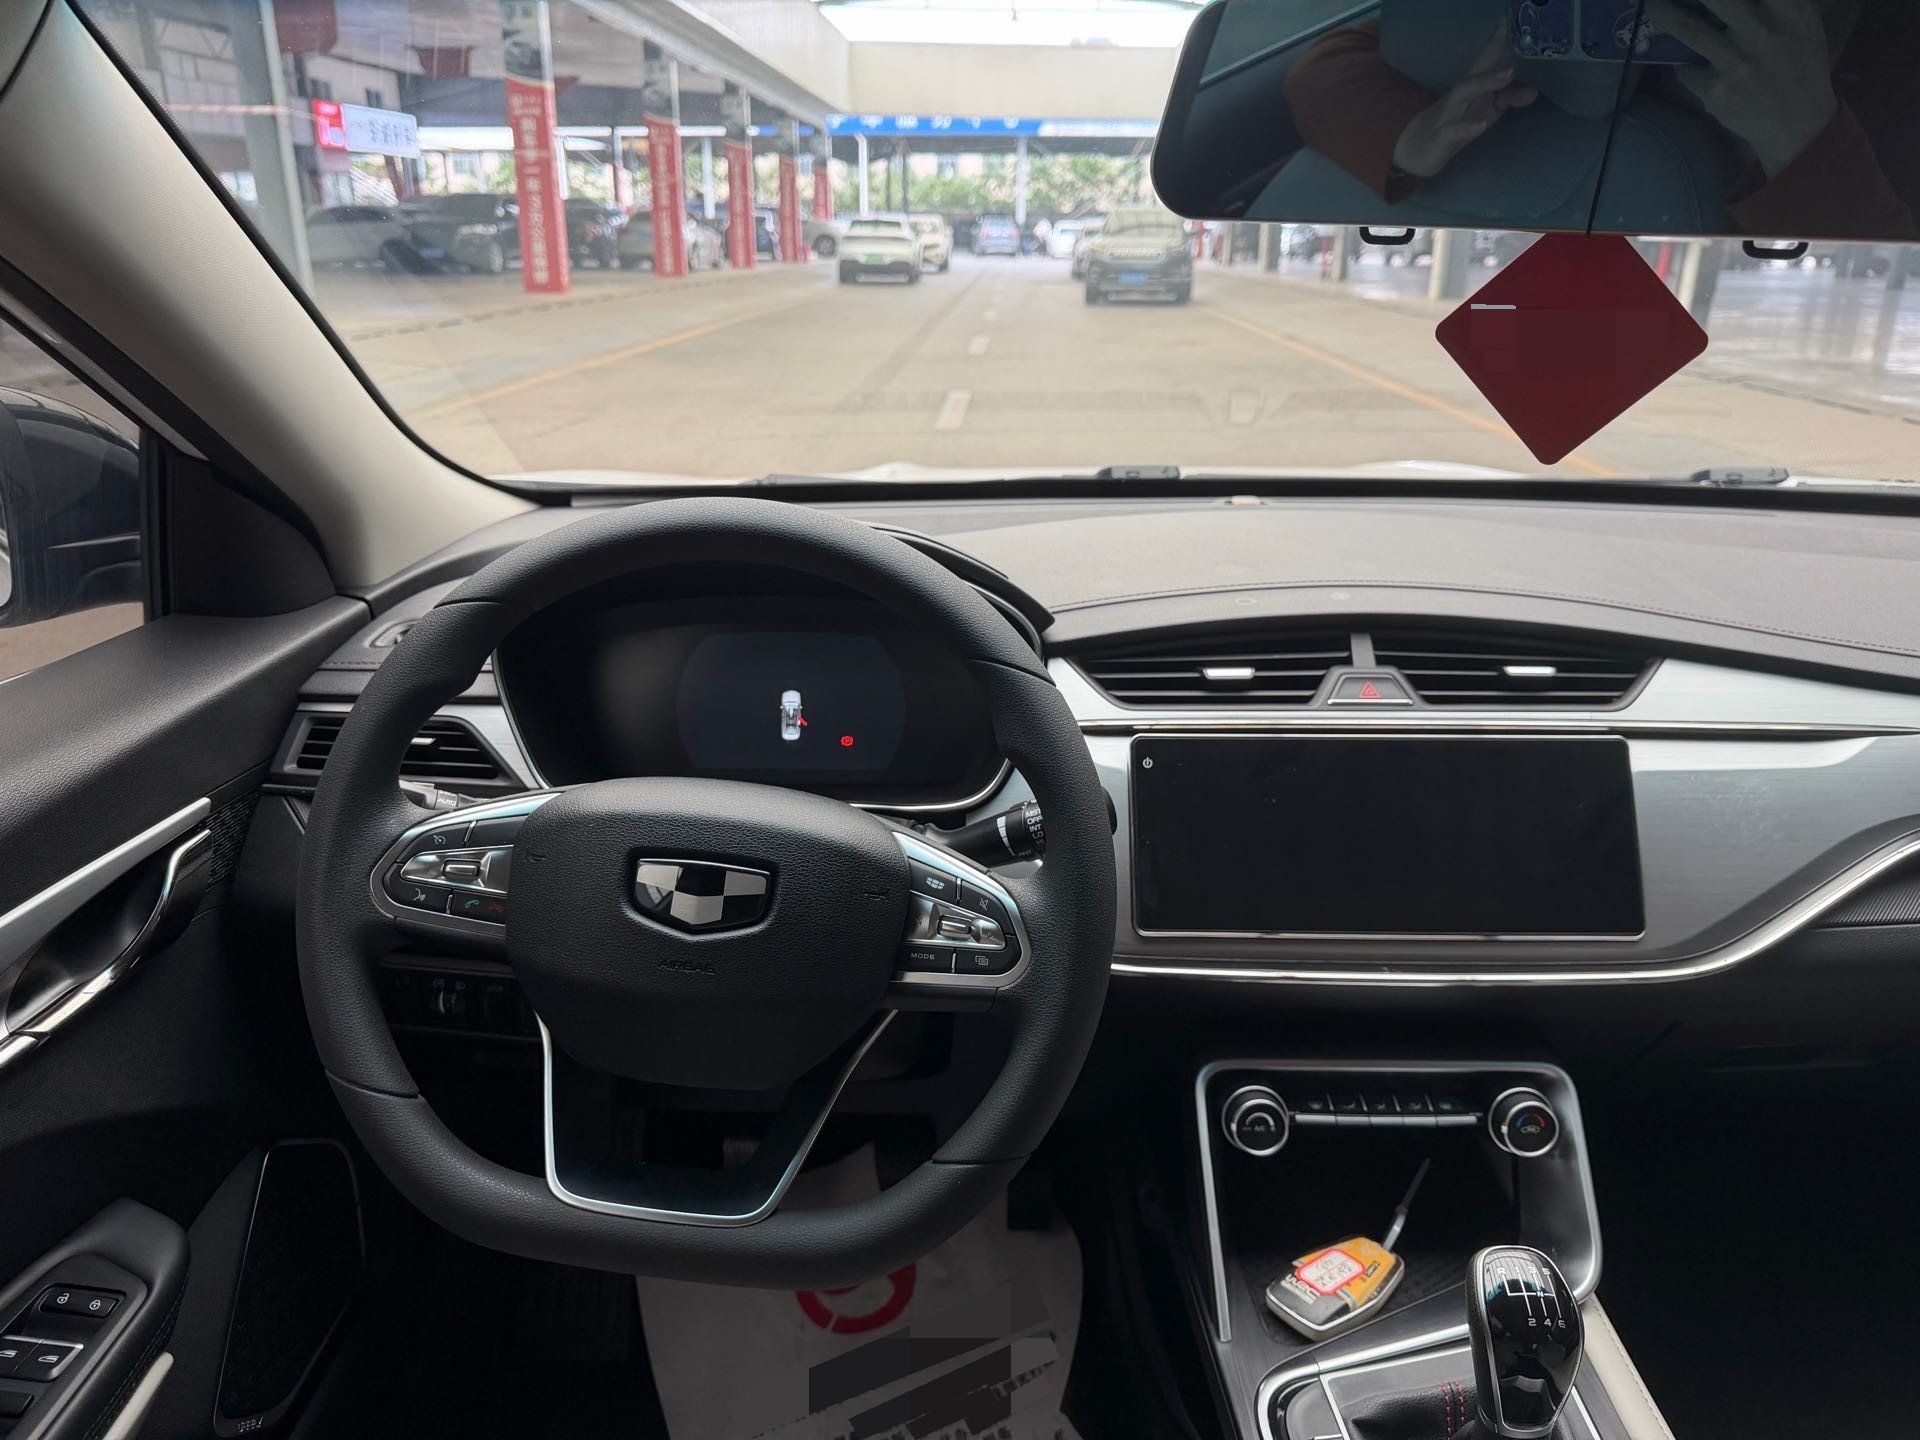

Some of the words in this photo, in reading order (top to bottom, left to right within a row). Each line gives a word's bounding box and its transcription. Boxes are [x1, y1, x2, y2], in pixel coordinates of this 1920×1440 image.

[437, 798, 456, 806] AUTO
[1029, 824, 1042, 832] INT
[1032, 831, 1044, 839] LO
[910, 952, 936, 960] MODE
[657, 959, 718, 975] AIRBAG
[1497, 1267, 1507, 1275] R
[1527, 1318, 1537, 1327] 2
[1543, 1319, 1552, 1327] 4
[1557, 1320, 1566, 1329] 6
